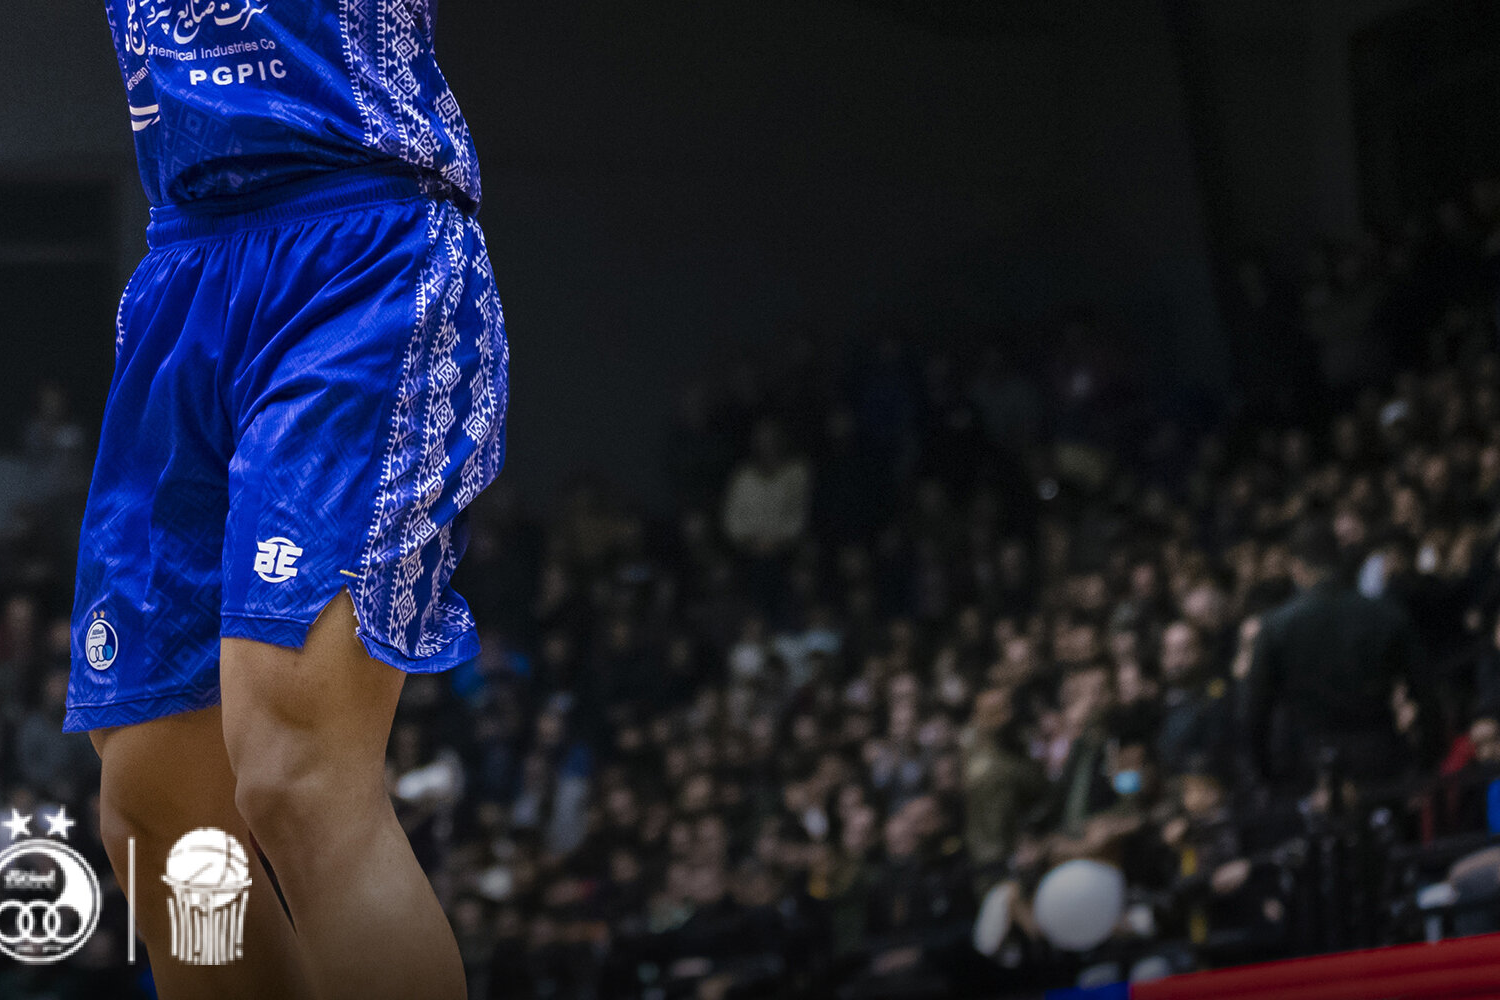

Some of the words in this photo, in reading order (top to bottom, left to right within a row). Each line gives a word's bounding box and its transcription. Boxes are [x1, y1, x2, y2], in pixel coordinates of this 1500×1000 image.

[201, 40, 259, 59] Industries
[260, 38, 276, 50] Co
[189, 59, 287, 86] PGPIC
